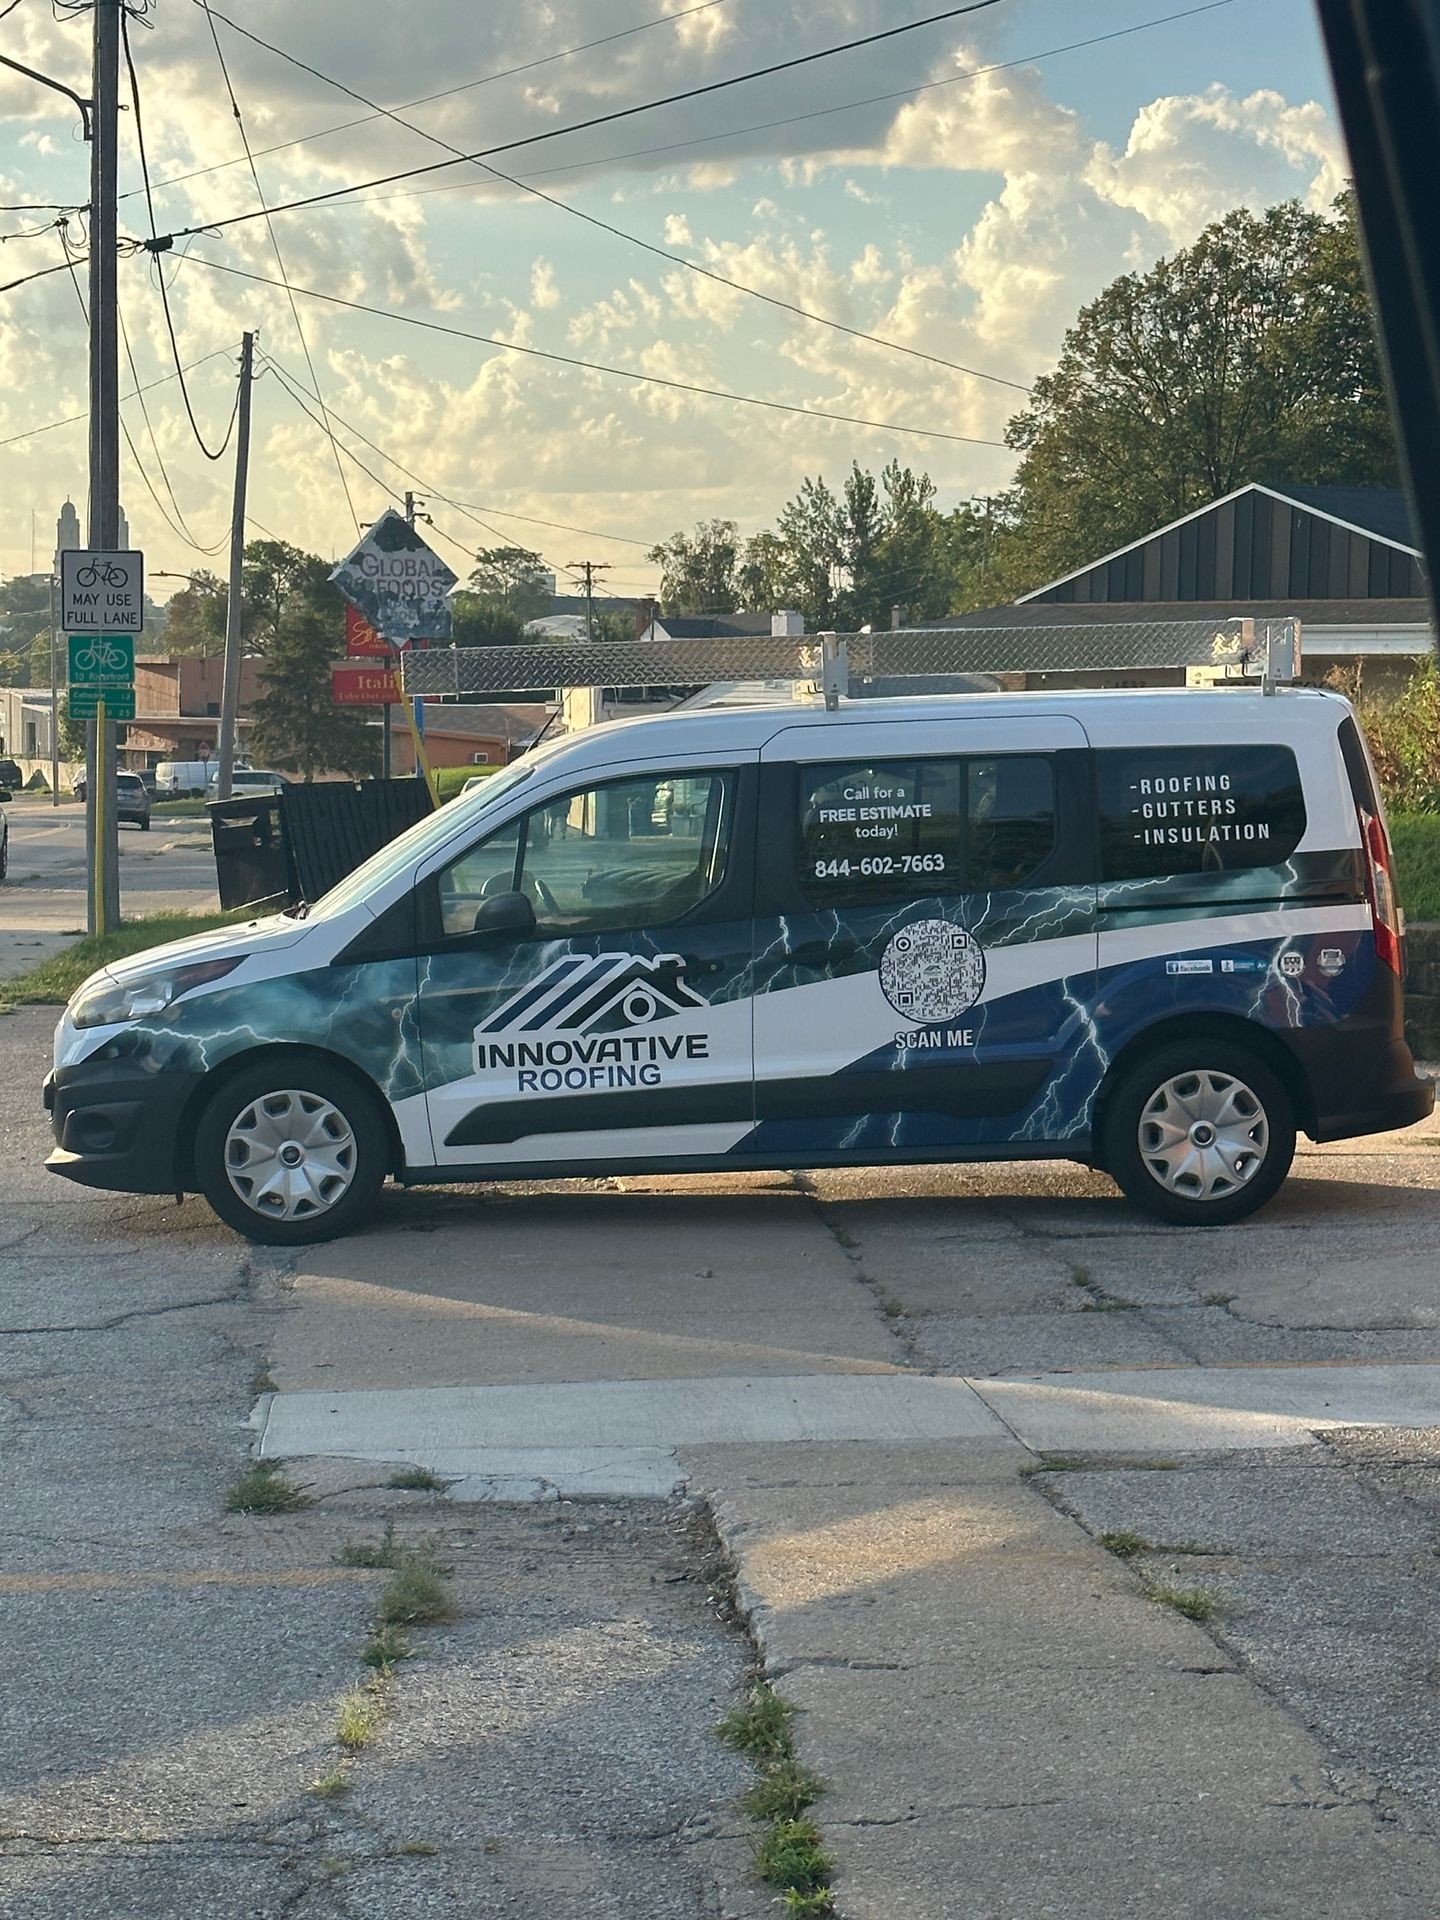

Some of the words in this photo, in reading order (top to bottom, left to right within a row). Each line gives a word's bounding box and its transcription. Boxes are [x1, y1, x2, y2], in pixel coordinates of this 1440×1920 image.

[361, 553, 439, 577] GLOBAL
[377, 580, 444, 597] FOODS
[73, 593, 100, 606] MAY
[106, 593, 132, 606] USE
[67, 611, 98, 624] FULL
[104, 612, 138, 625] LANE
[89, 672, 129, 681] Riverfront
[358, 674, 394, 689] Itali
[843, 786, 870, 800] Call
[873, 786, 892, 799] for
[896, 787, 906, 798] a
[1130, 774, 1231, 795] -ROOFING
[819, 808, 856, 823] FREE
[860, 804, 932, 821] ESTIMATE
[1131, 798, 1236, 819] -GUTTERS
[854, 823, 898, 839] today!
[1133, 823, 1271, 845] -INSULATION
[814, 853, 945, 878] 844-602-7663
[1180, 963, 1211, 972] facebook
[895, 1031, 942, 1049] SCAN
[947, 1029, 974, 1047] ME
[478, 1034, 710, 1069] INNOVATIVE
[518, 1064, 661, 1092] ROOFING
